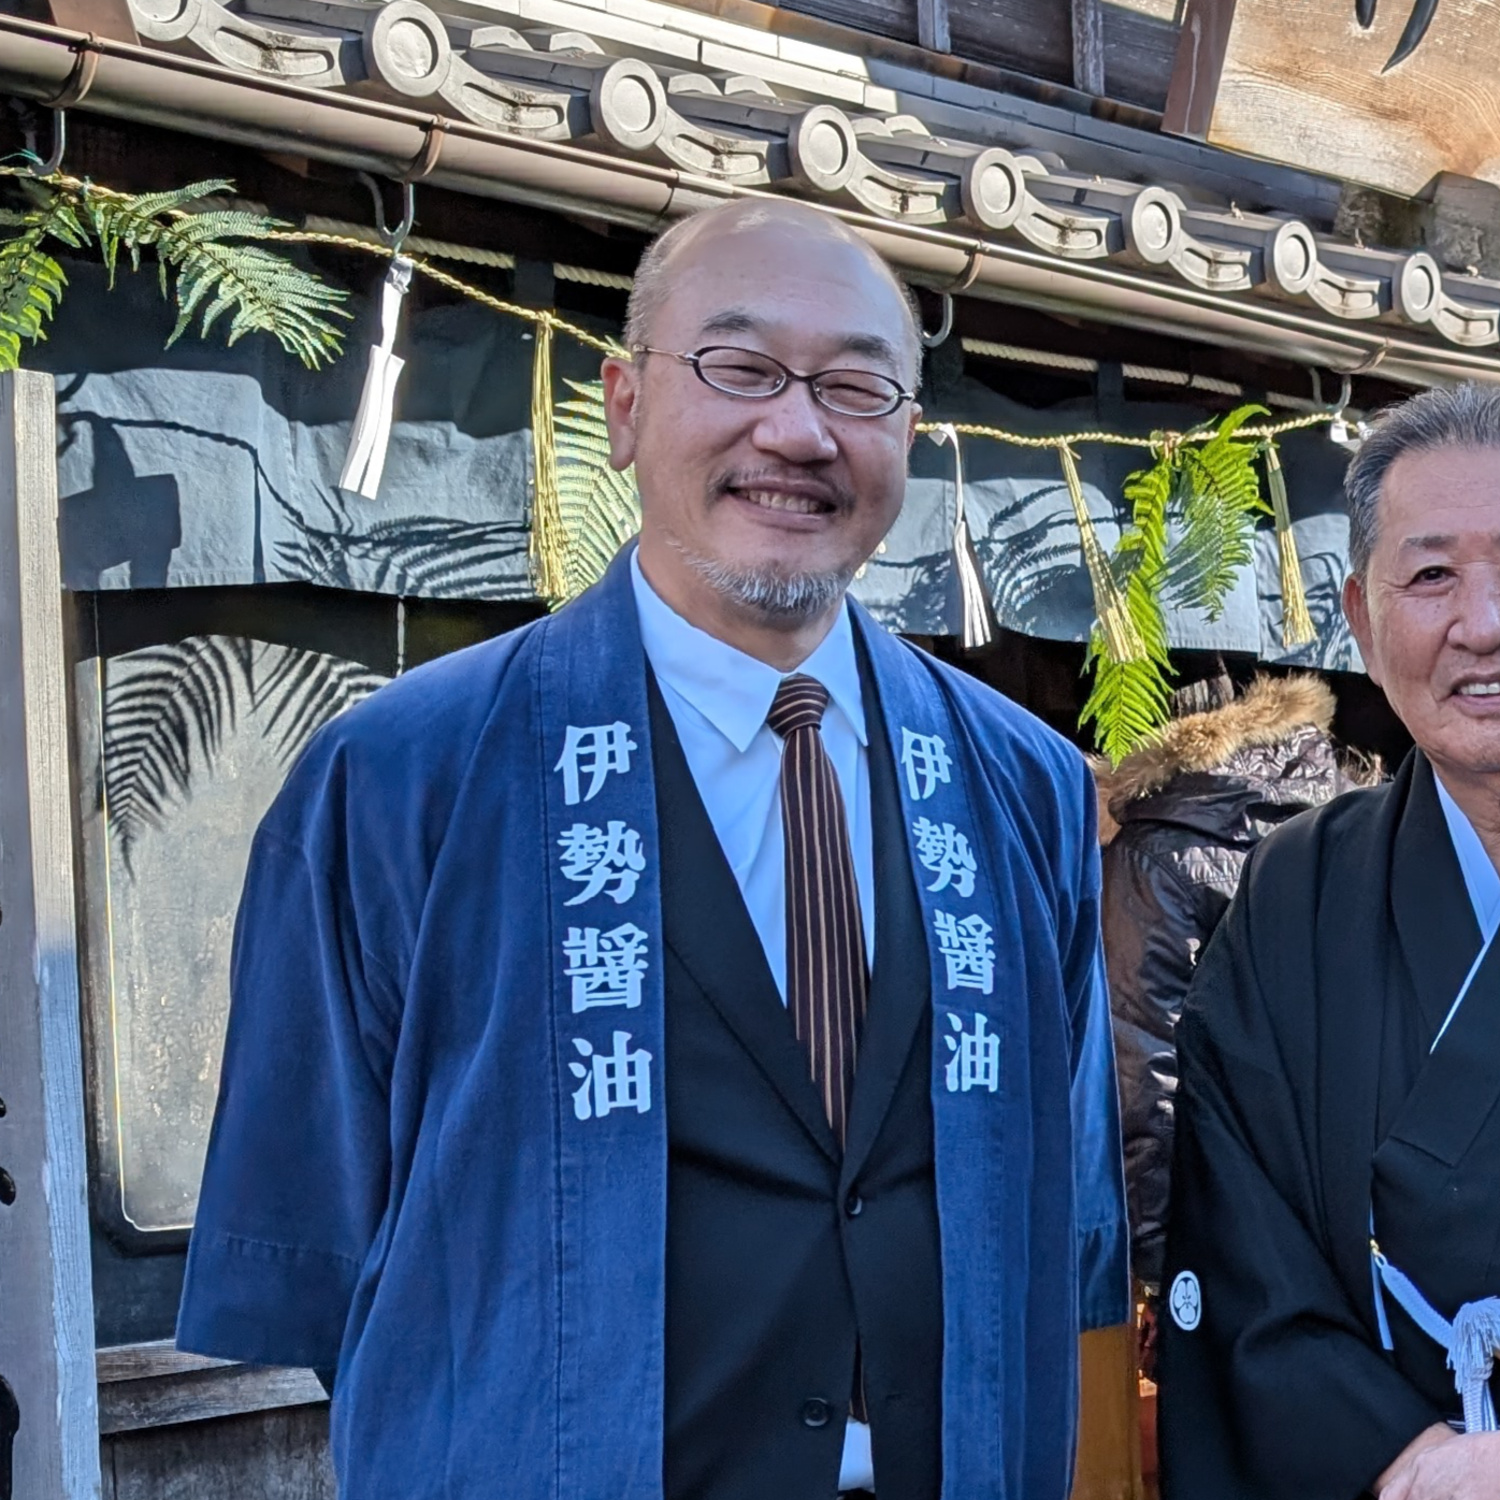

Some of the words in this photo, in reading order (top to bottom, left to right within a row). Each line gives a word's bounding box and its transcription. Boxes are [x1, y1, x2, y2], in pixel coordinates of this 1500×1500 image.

[553, 720, 653, 1121] 伊勢醬油
[901, 725, 1000, 1093] 伊勢醬油
